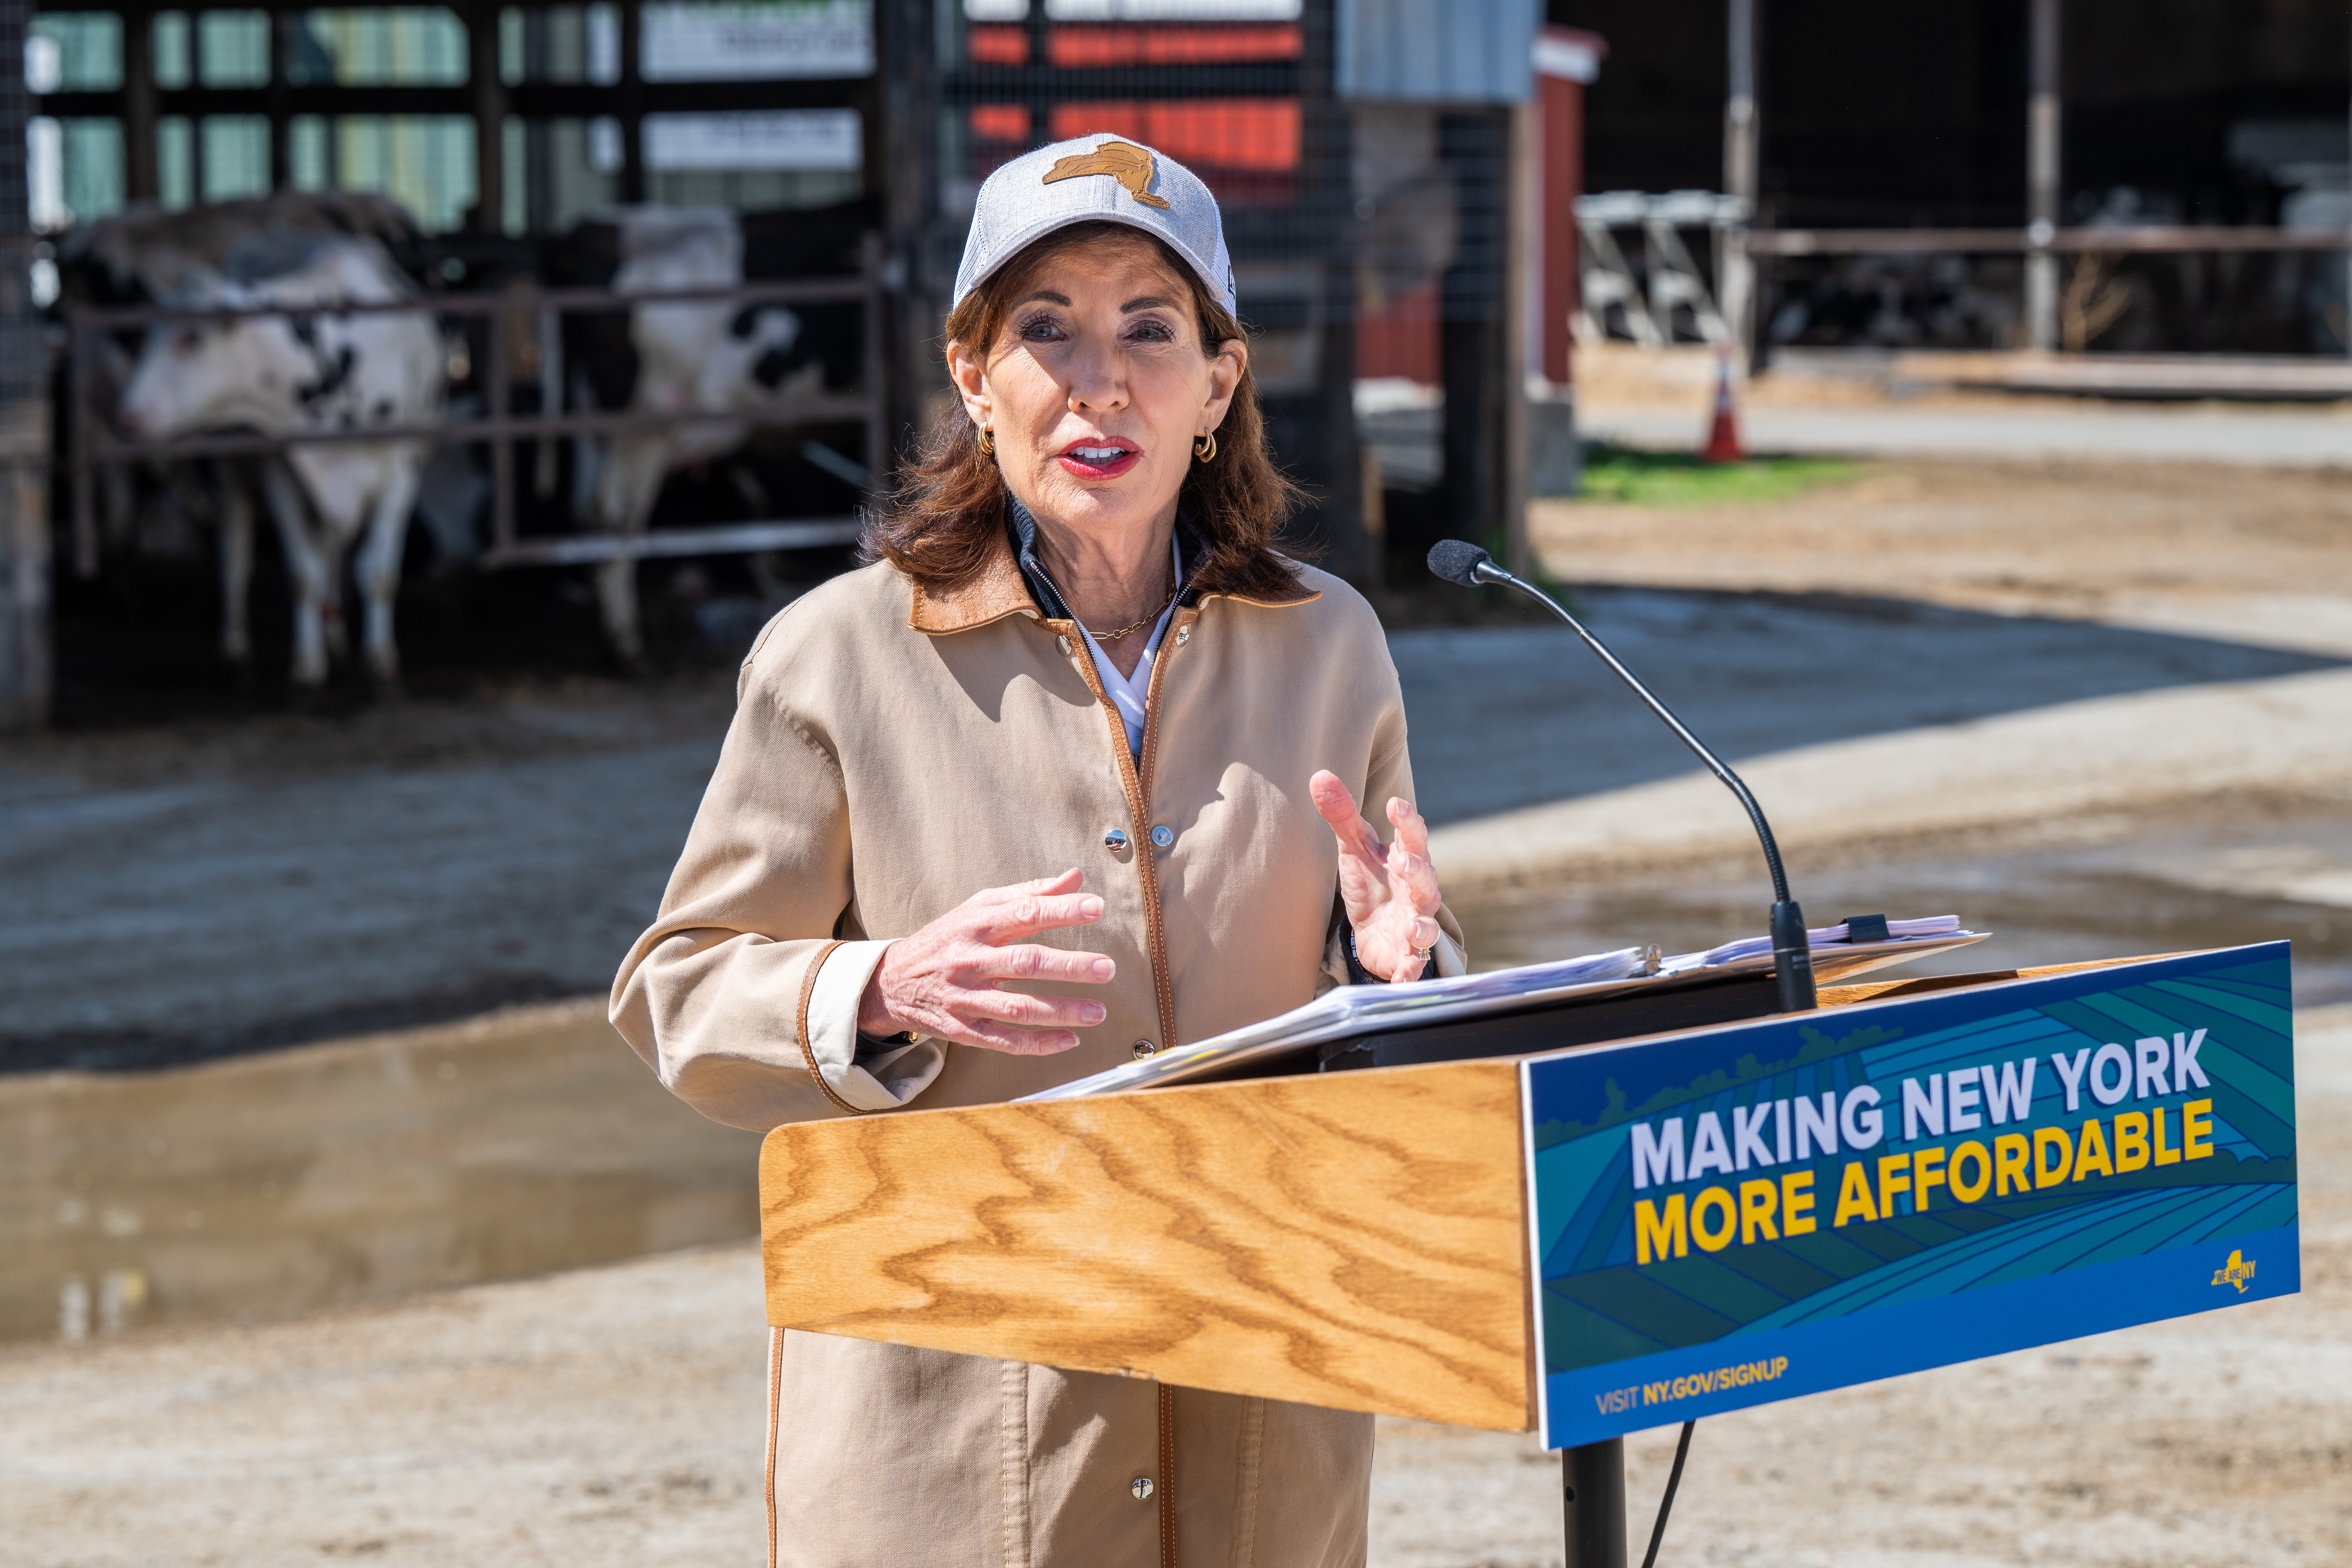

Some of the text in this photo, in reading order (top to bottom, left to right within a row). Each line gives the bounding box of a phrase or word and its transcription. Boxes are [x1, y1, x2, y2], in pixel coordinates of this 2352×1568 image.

[1632, 1028, 2211, 1189] MAKING NEW YORK
[1634, 1098, 2214, 1265] MORE AFFORDABLE
[2216, 1260, 2256, 1283] WE ARE NY
[1595, 1356, 1789, 1415] VISIT NY.GOV/SIGNUP
